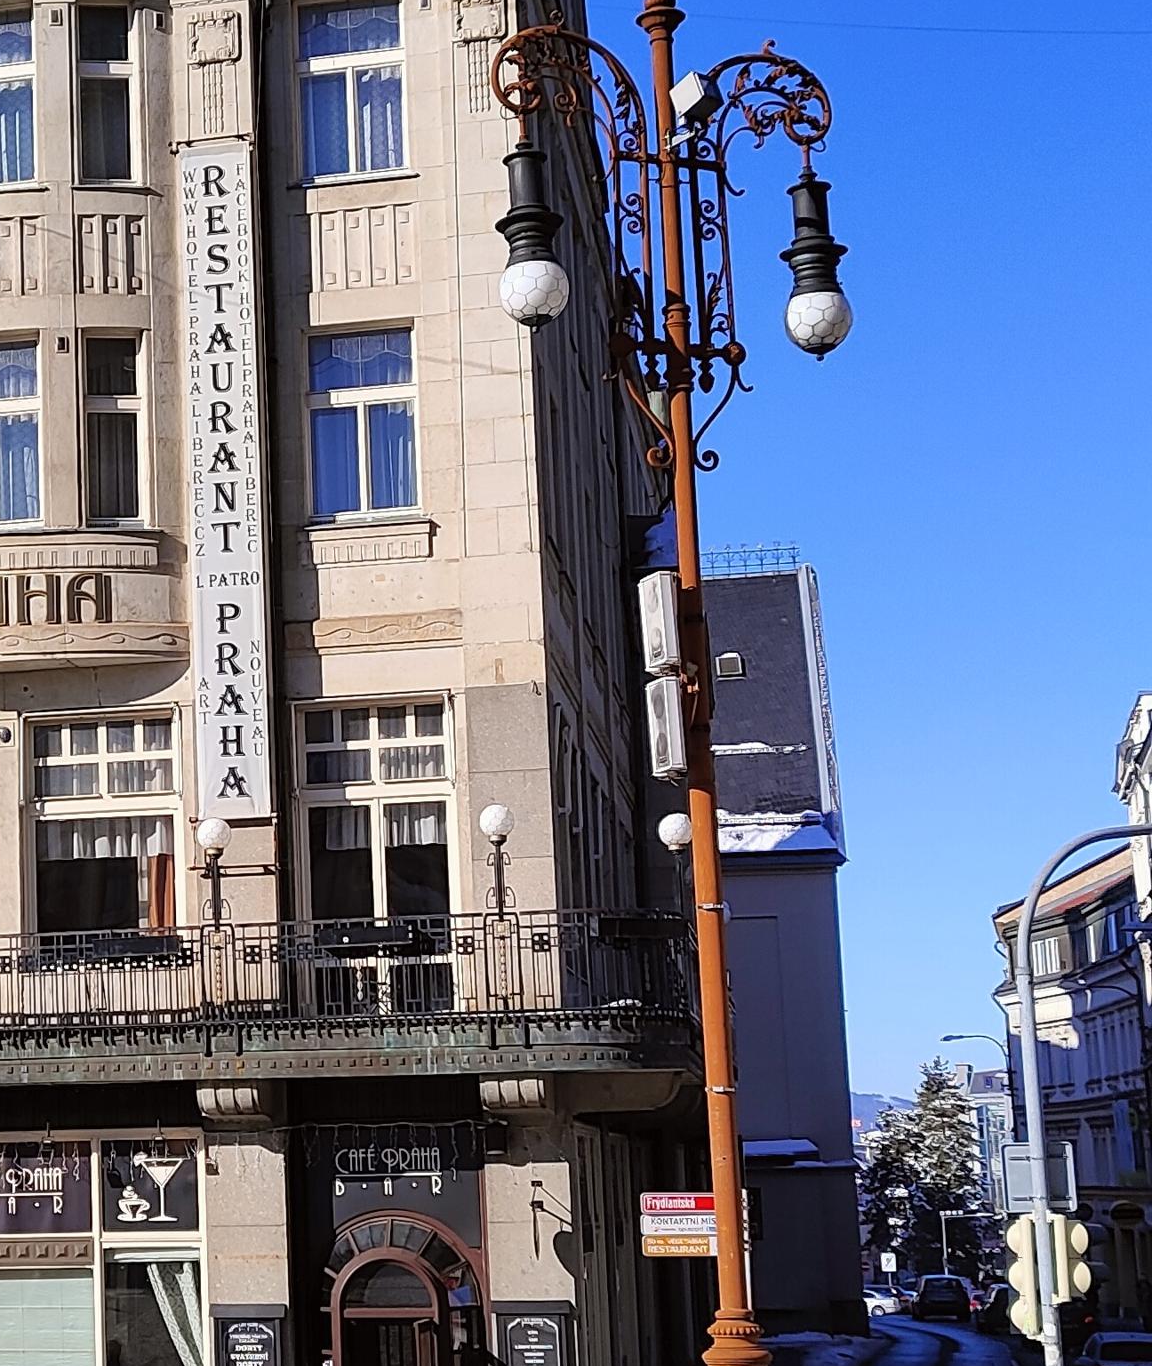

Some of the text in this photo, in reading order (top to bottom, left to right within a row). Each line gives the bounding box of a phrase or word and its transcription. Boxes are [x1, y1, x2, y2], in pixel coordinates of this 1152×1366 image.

[202, 164, 250, 799] RESTAURANT PRAHA
[209, 571, 260, 587] PATRO
[198, 676, 210, 726] ART
[248, 639, 266, 757] NOUVEAU
[335, 1143, 441, 1174] CAFÉ PRAHA
[5, 1167, 63, 1194] PRAHA
[701, 1217, 717, 1225] MÍS
